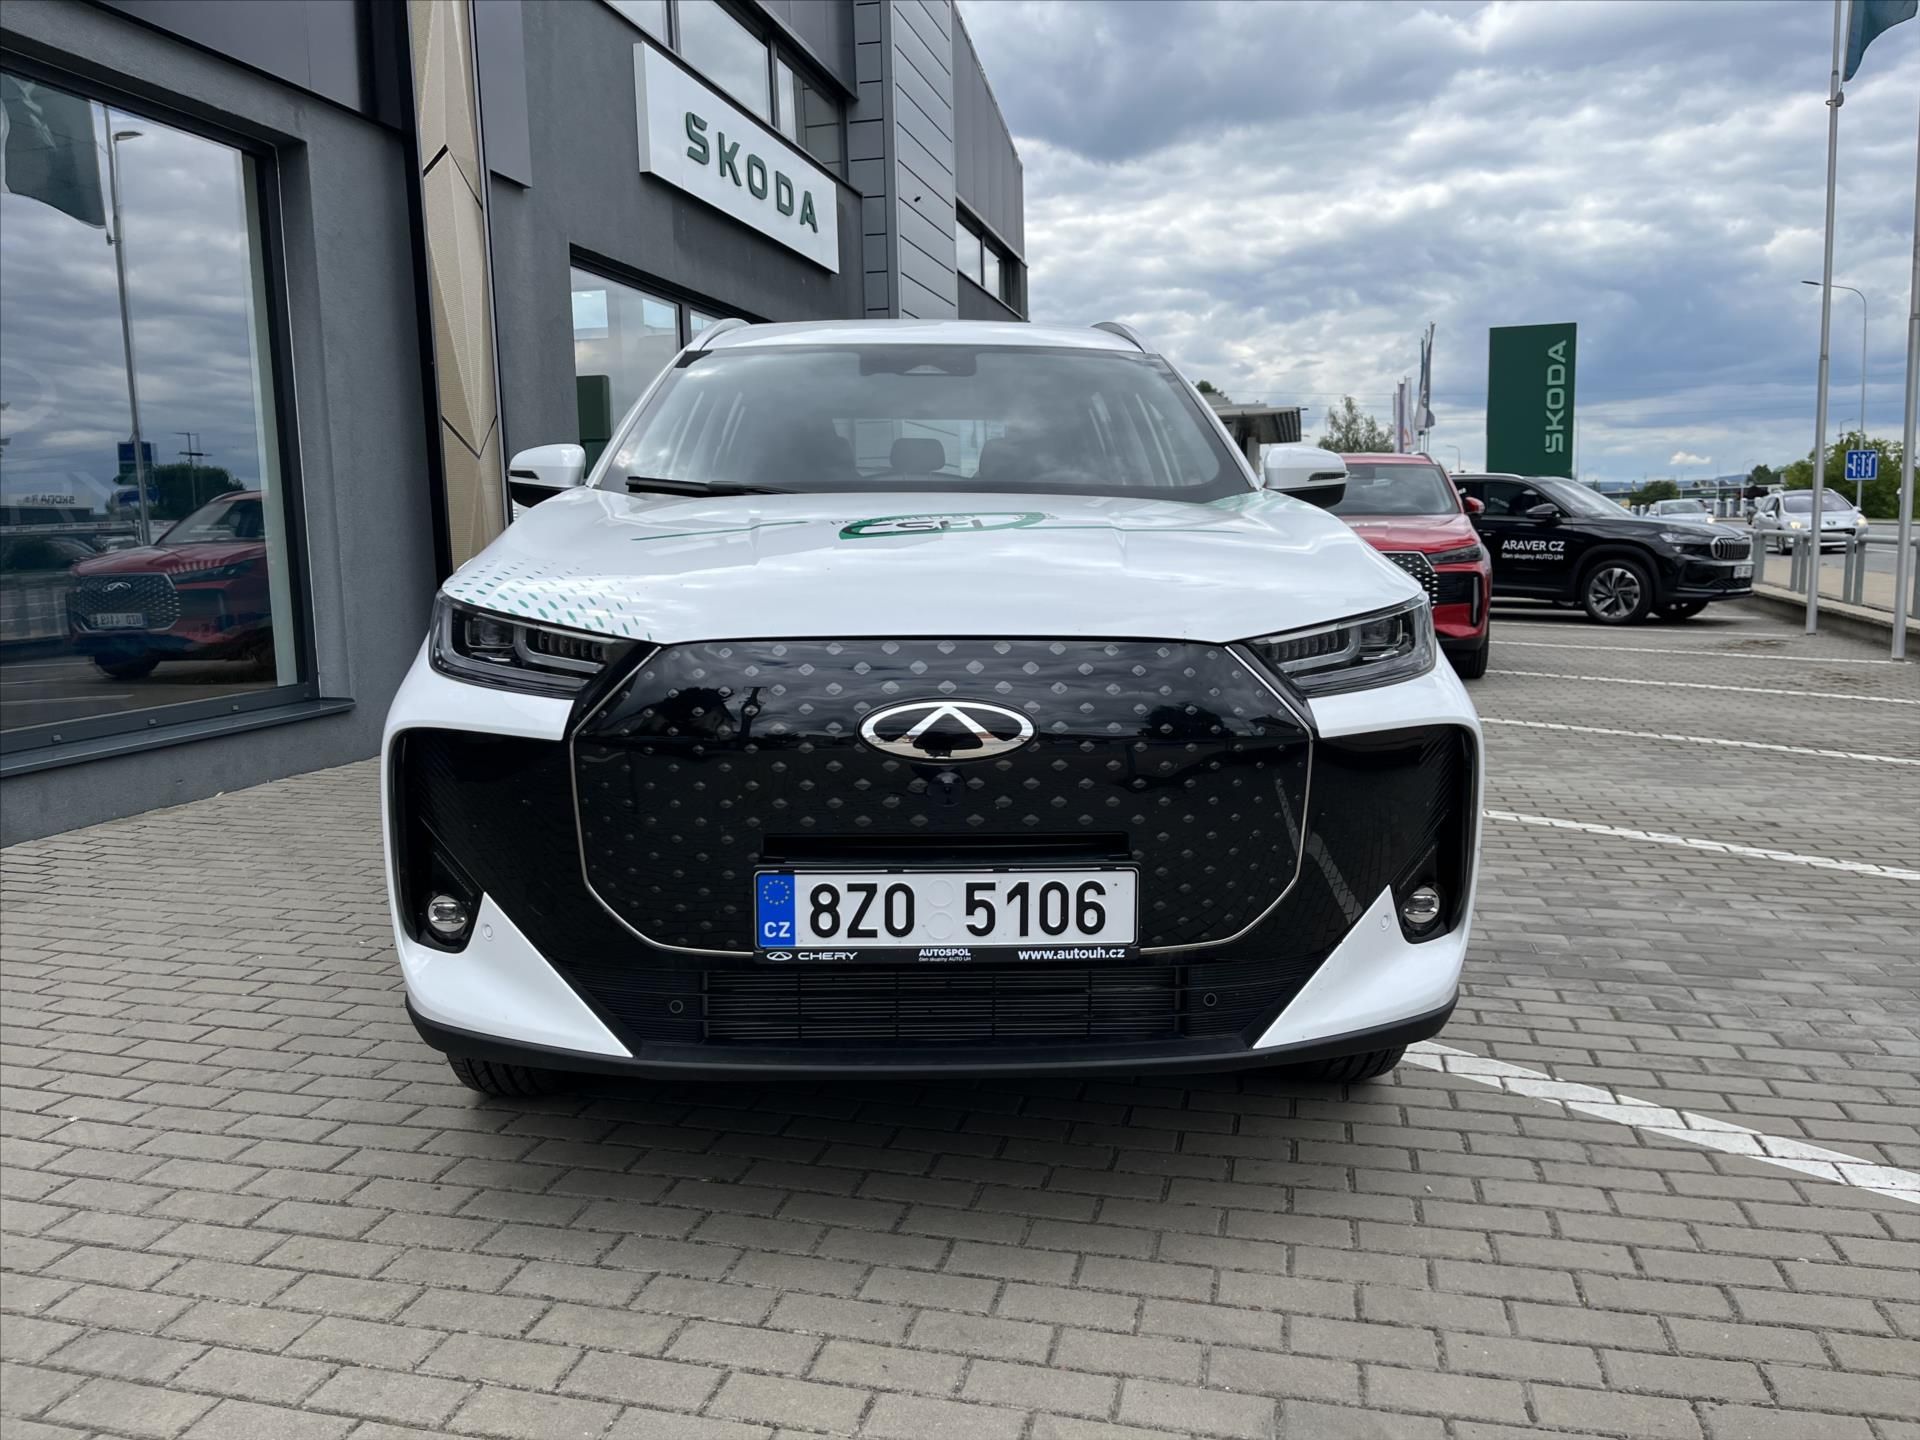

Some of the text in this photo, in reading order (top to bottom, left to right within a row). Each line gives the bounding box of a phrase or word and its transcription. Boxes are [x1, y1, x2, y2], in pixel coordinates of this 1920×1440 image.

[1502, 540, 1565, 552] ARAVER CZ
[764, 880, 1106, 938] CZ 8Z0 5106
[798, 952, 858, 960] CHERY
[919, 948, 971, 957] AUTOSPOL
[1018, 947, 1125, 960] www.autouh.cz
